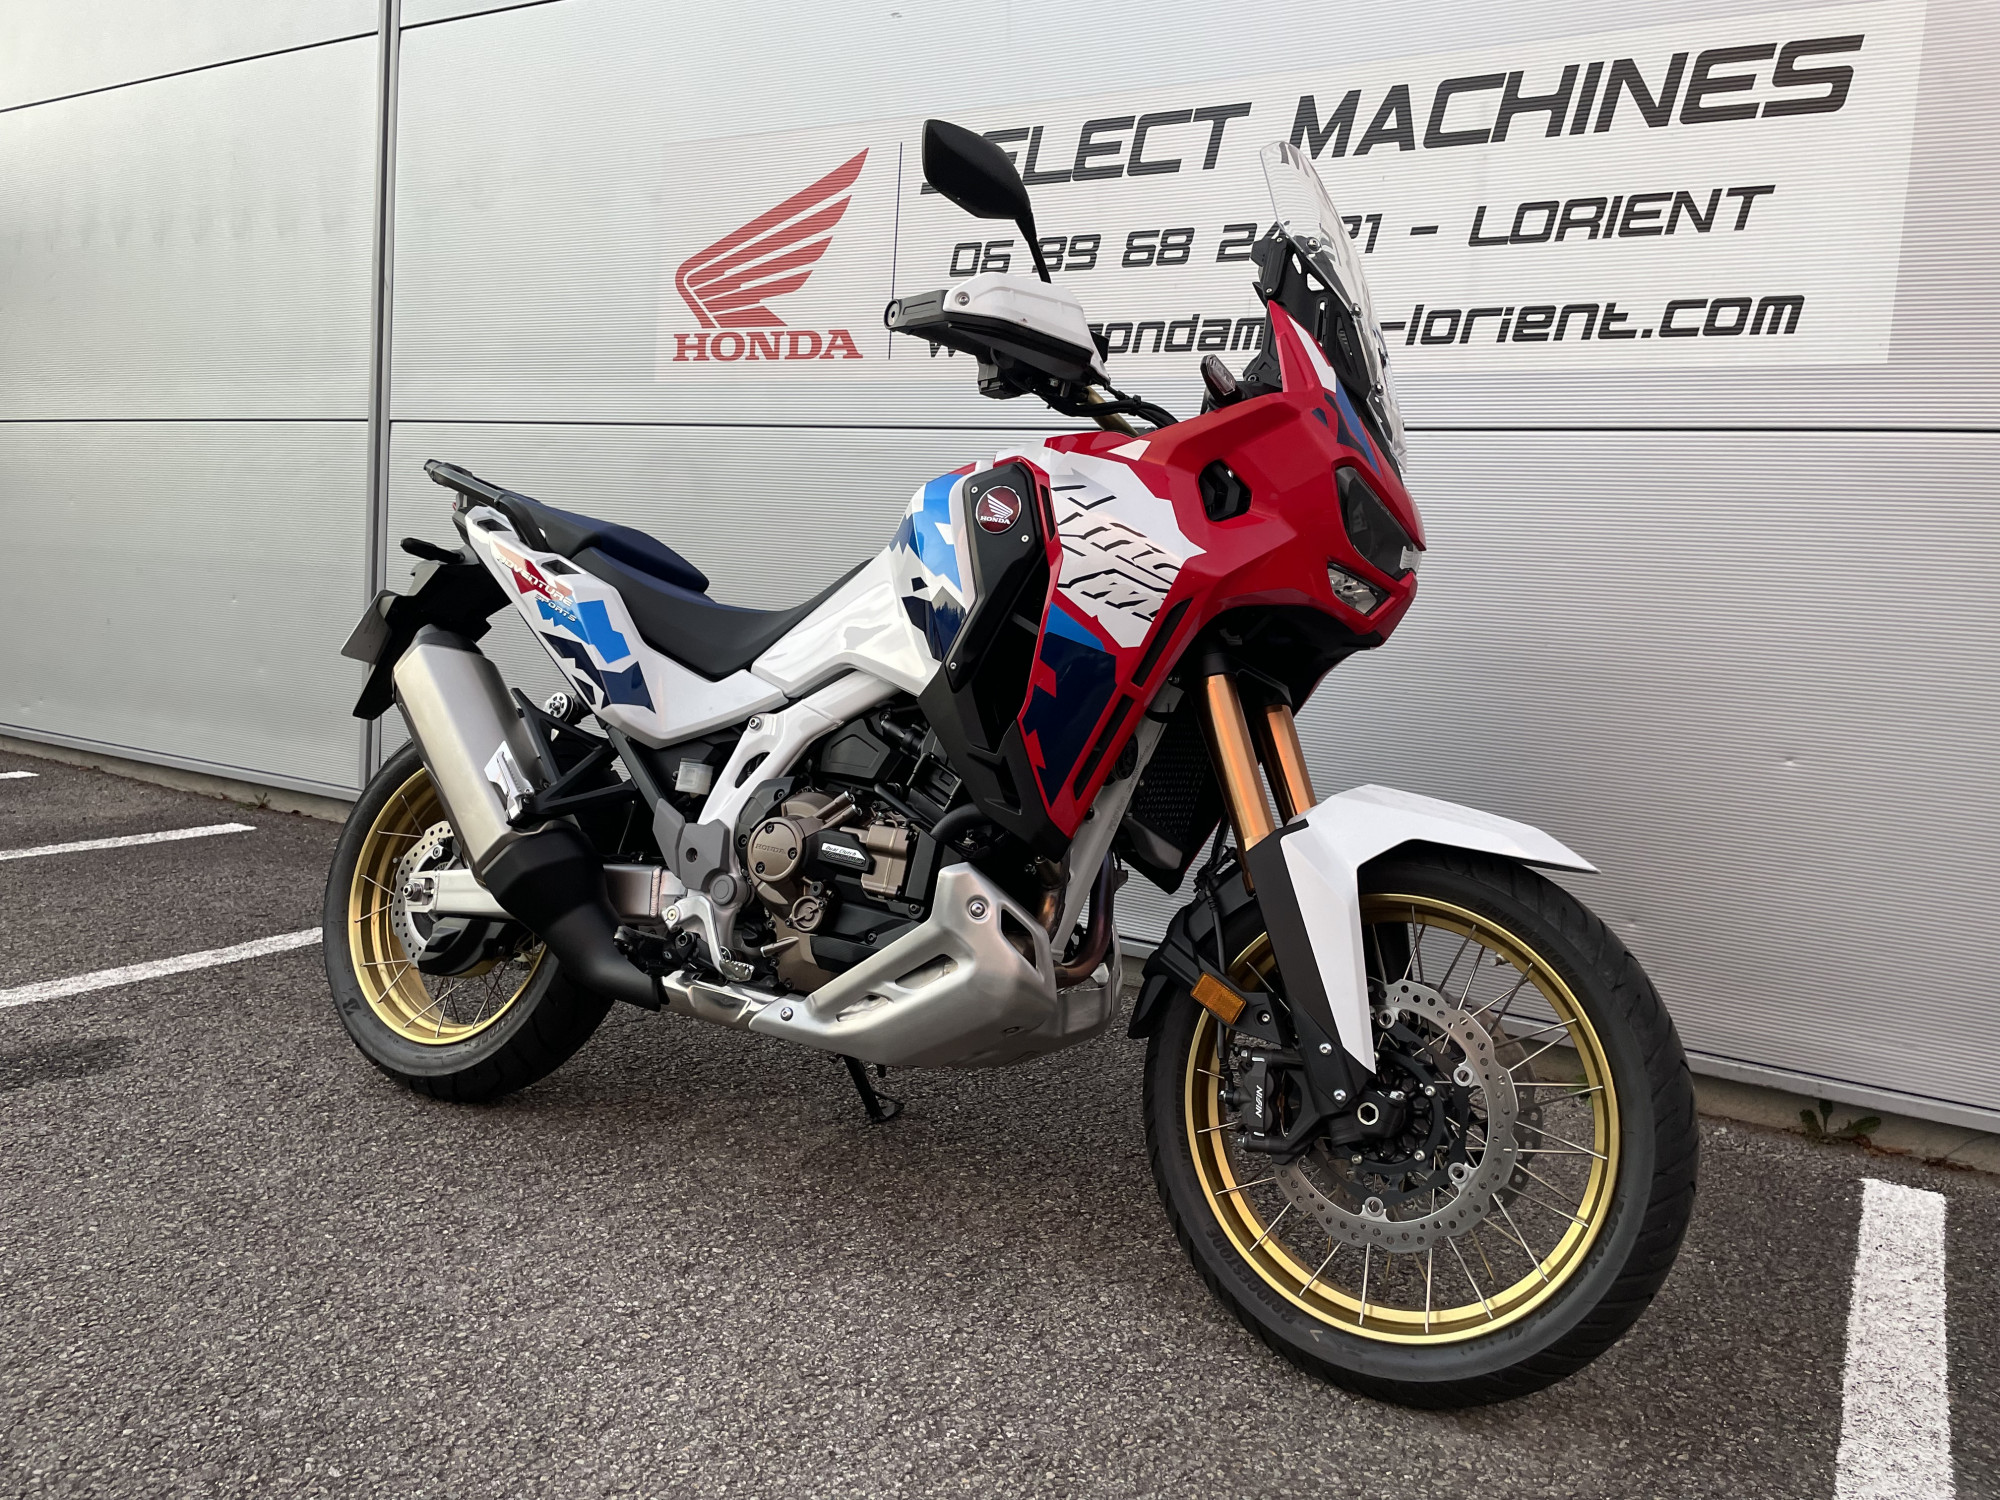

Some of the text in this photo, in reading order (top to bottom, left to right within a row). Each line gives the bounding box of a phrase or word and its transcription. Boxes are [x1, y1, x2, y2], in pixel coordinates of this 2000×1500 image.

[1280, 34, 1865, 162] MACHINES
[949, 239, 1014, 277] 06
[1122, 227, 1195, 268] 68
[1468, 184, 1776, 247] LORIENT
[673, 329, 863, 361] HONDA
[980, 515, 1011, 525] HONDA
[497, 555, 574, 607] ADVENTURE
[534, 593, 578, 622] SPORTS
